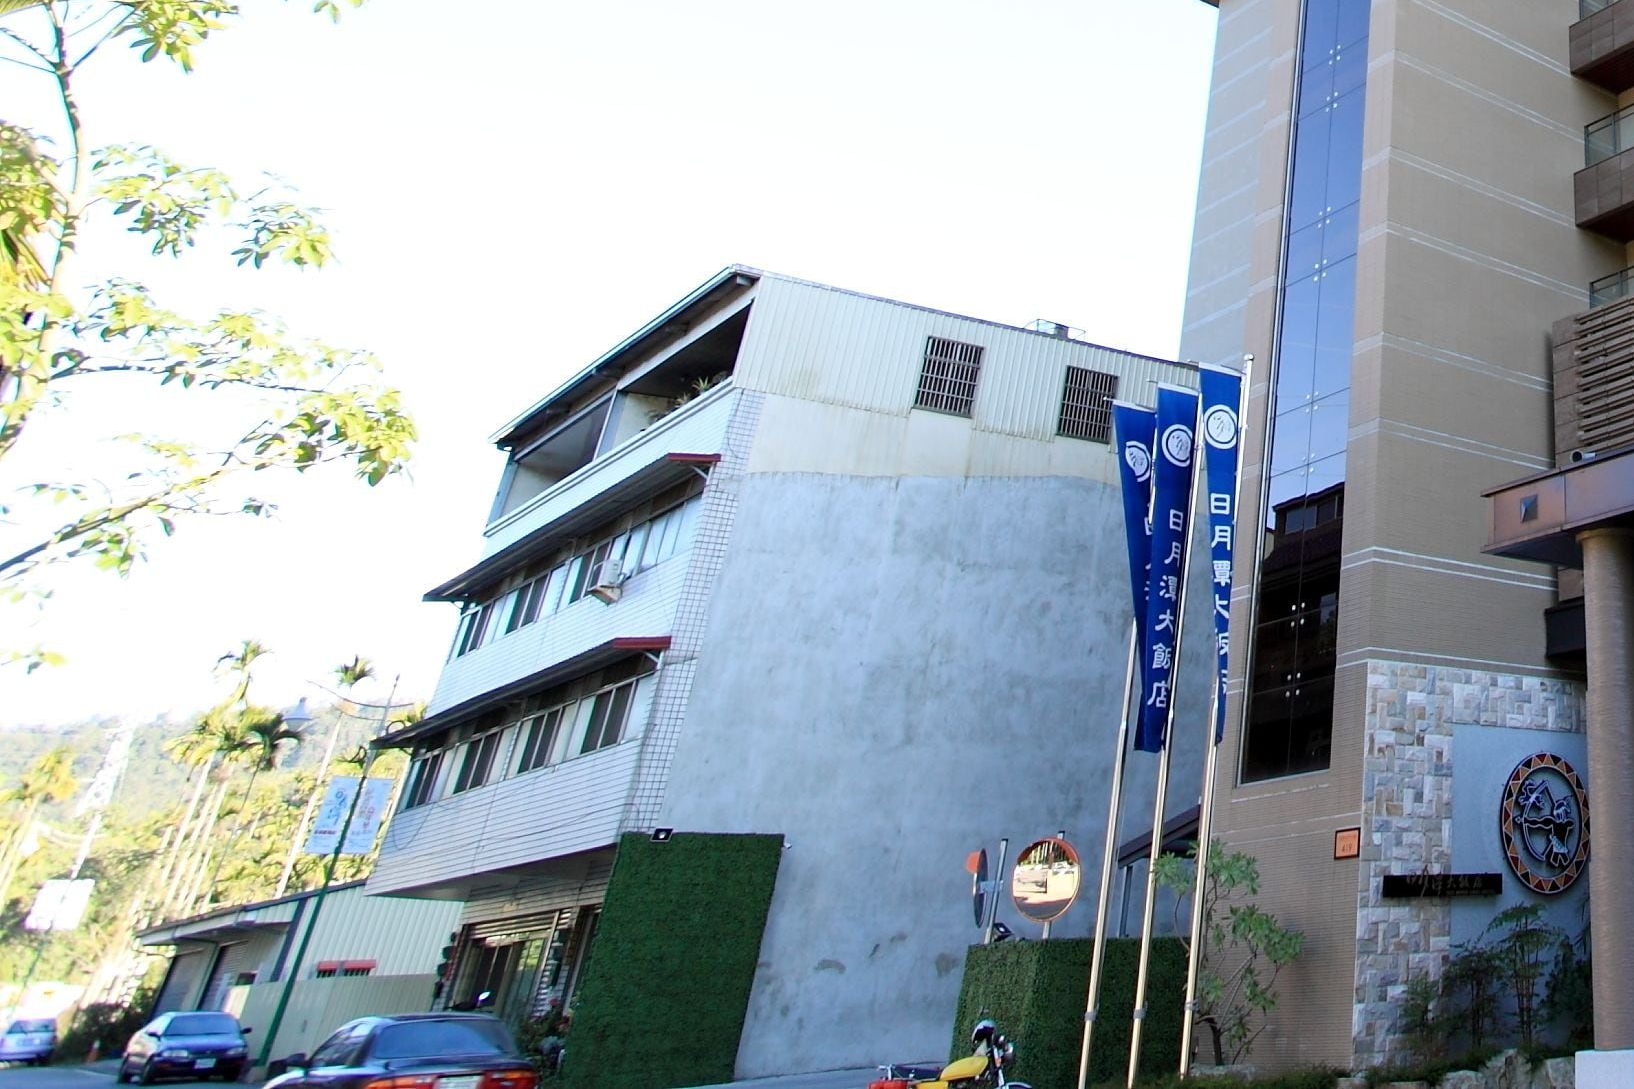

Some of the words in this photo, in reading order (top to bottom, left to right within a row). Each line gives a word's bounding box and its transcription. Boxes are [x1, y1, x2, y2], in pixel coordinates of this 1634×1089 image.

[1147, 509, 1183, 708] 日月潭大飯店
